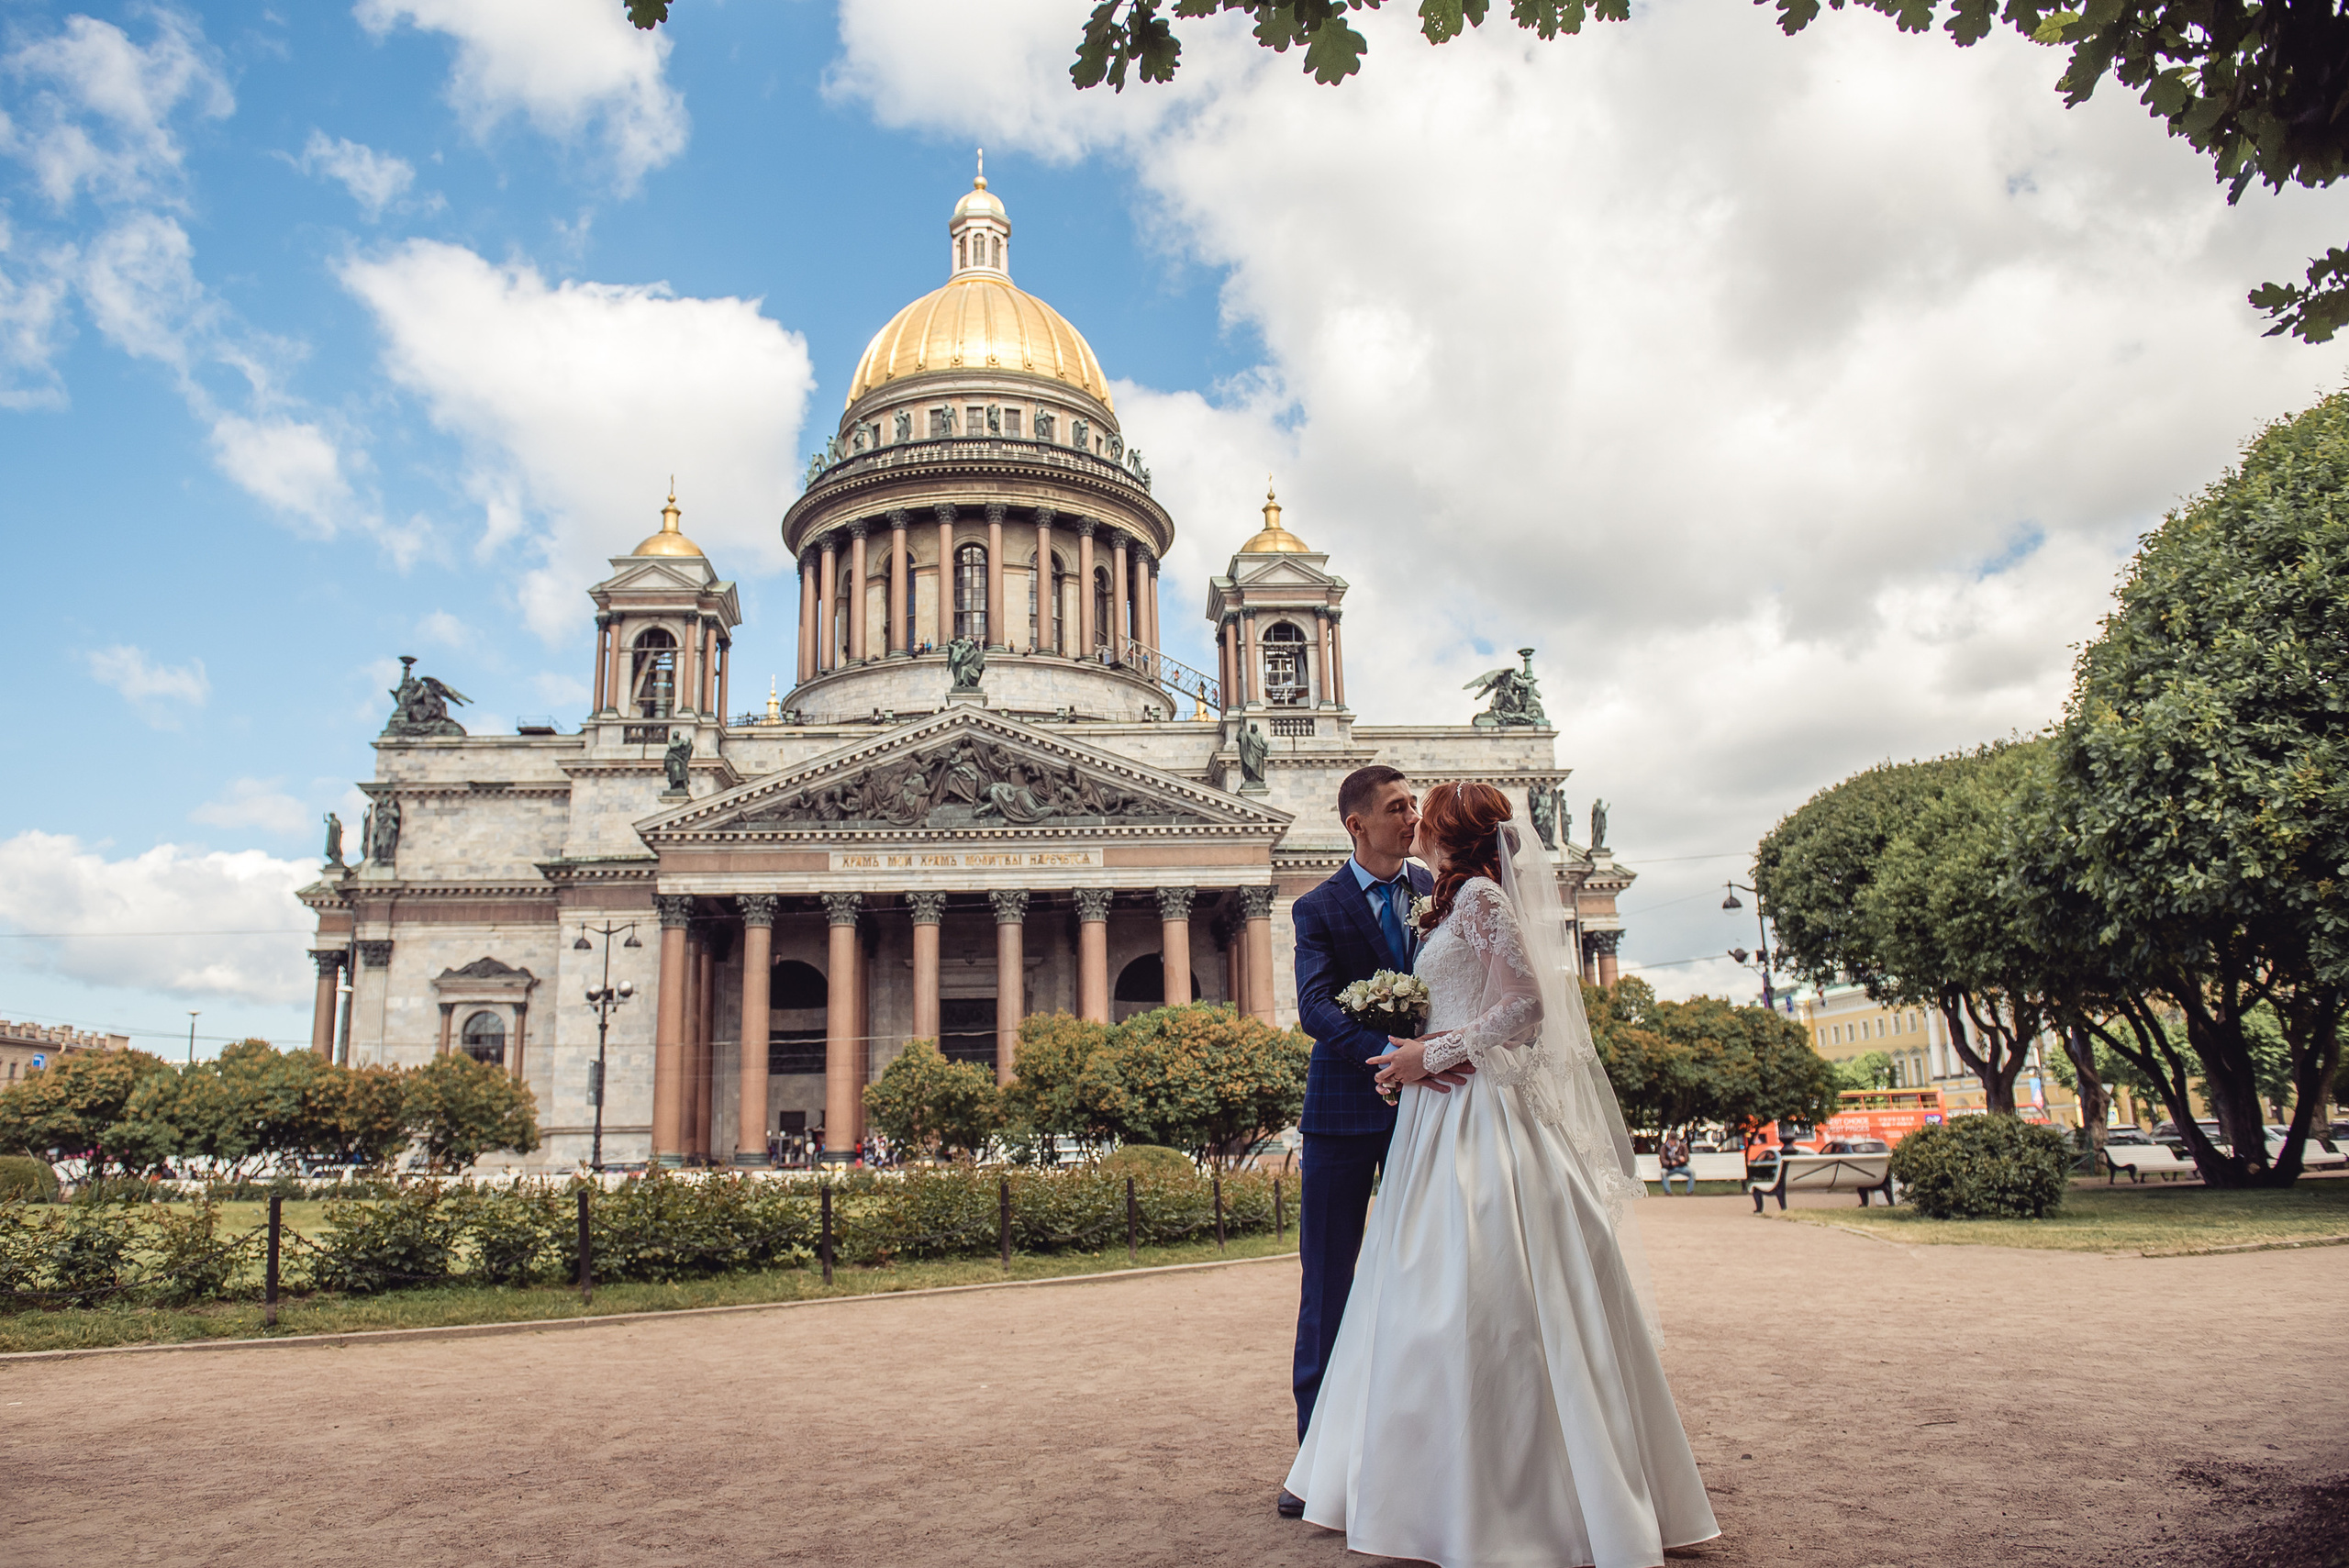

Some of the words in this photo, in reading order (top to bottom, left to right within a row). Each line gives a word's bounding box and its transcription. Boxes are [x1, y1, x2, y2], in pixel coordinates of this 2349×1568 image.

[842, 854, 880, 868] ХРАМЪ
[920, 854, 957, 867] ХРАМЪ
[965, 853, 1022, 866] МОЛИТВЫ
